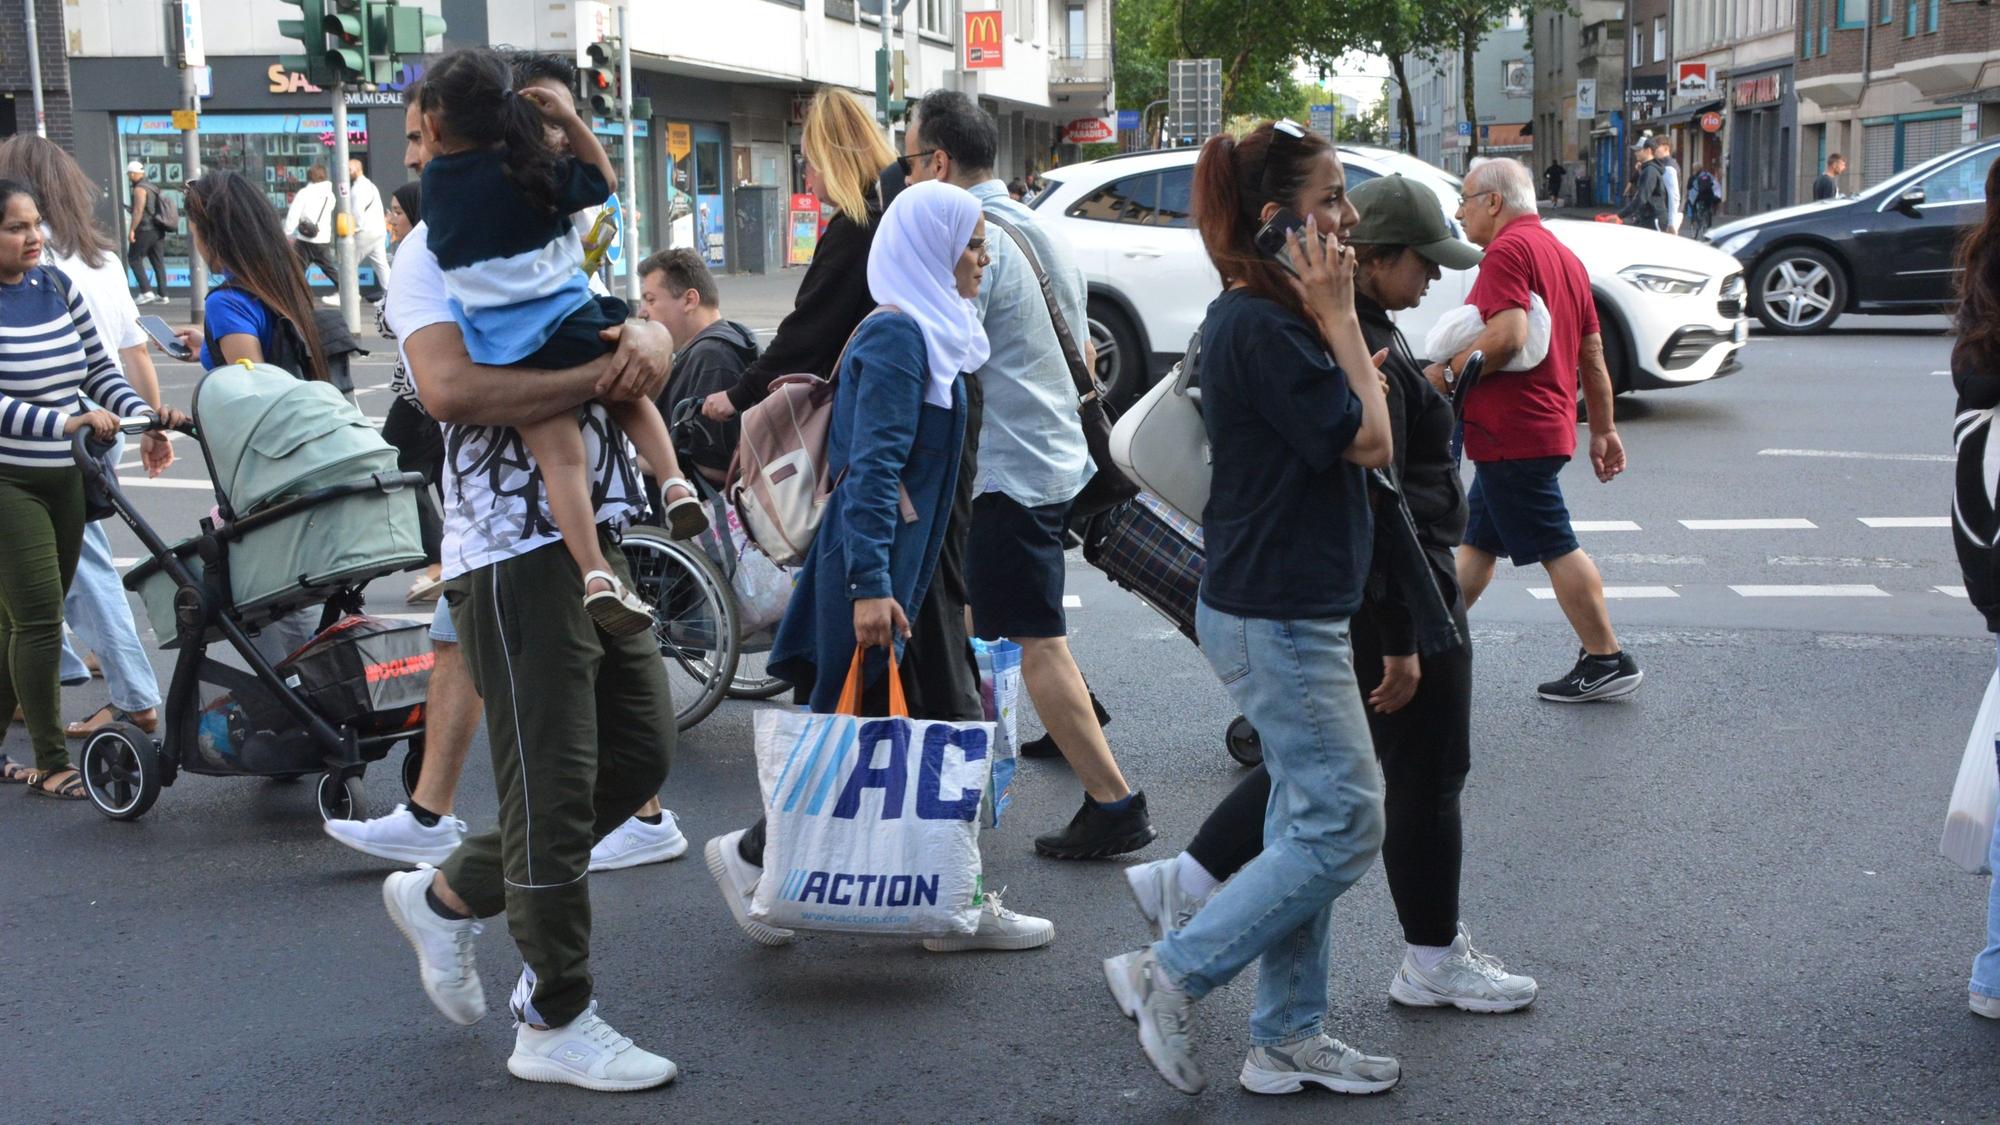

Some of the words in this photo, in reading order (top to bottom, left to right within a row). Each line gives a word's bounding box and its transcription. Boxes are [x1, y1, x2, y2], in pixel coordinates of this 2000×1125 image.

[375, 93, 402, 104] DEALE
[1657, 89, 1665, 101] 2
[1077, 121, 1100, 129] FISCH
[1070, 129, 1106, 137] PARADIES
[365, 652, 435, 682] WOOLWOR
[798, 871, 940, 906] ACTION
[800, 910, 910, 925] www.action.com
